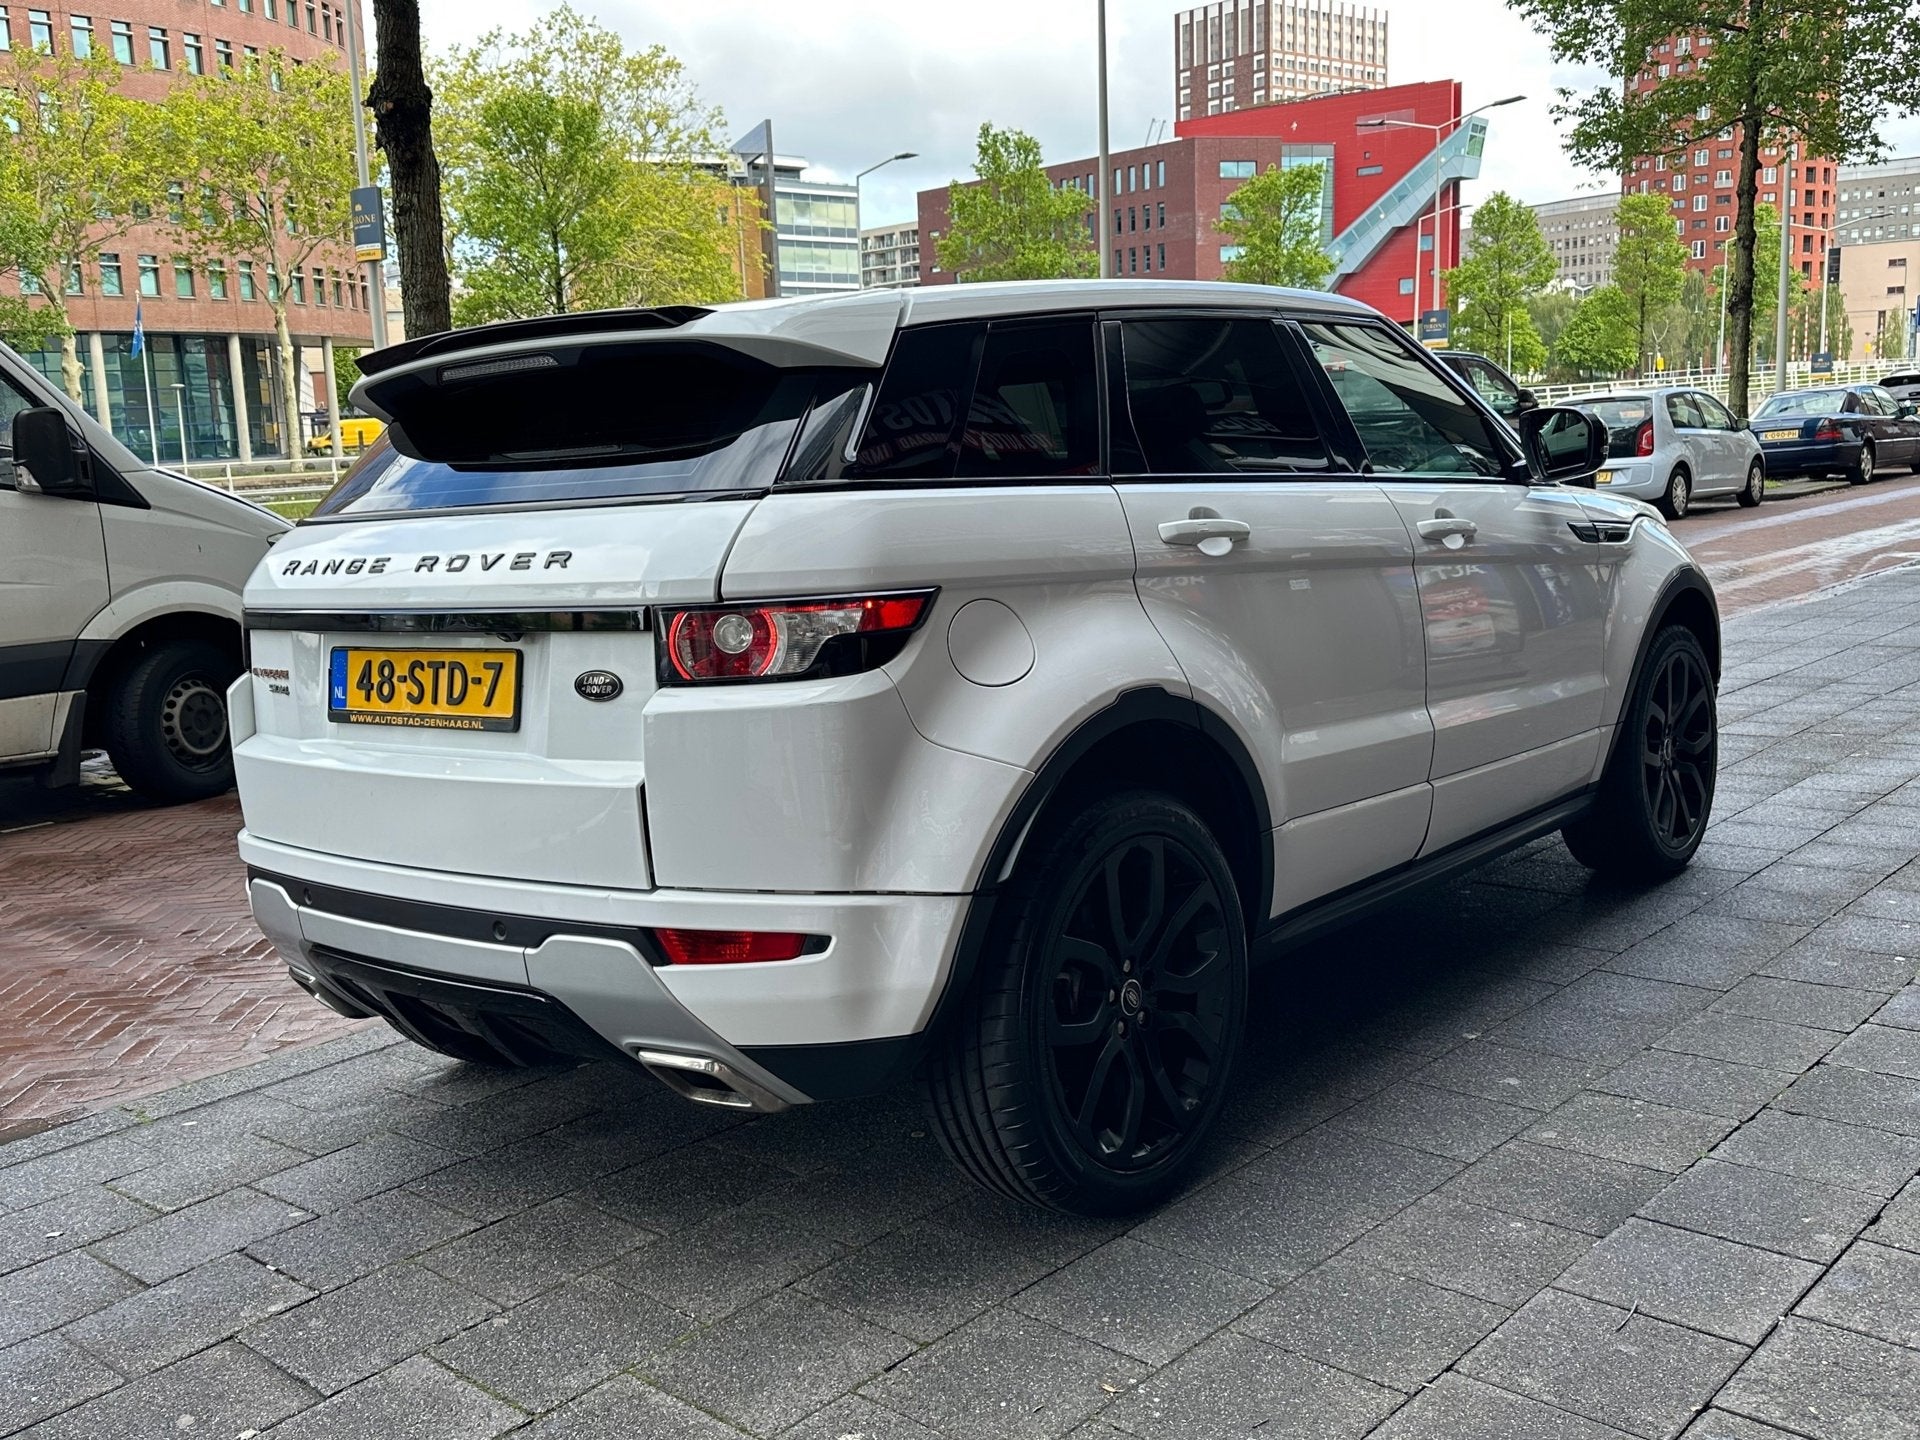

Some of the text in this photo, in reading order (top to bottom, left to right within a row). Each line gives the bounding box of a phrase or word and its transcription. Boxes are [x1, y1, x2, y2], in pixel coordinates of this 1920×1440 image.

[281, 550, 573, 576] RANGE ROVER
[356, 659, 504, 707] 48-STD-7
[583, 676, 605, 685] LAND
[334, 686, 346, 699] NL
[585, 685, 613, 694] ROVER
[349, 713, 484, 729] WWW.AUTOSTAD-DENHAAG.NL
